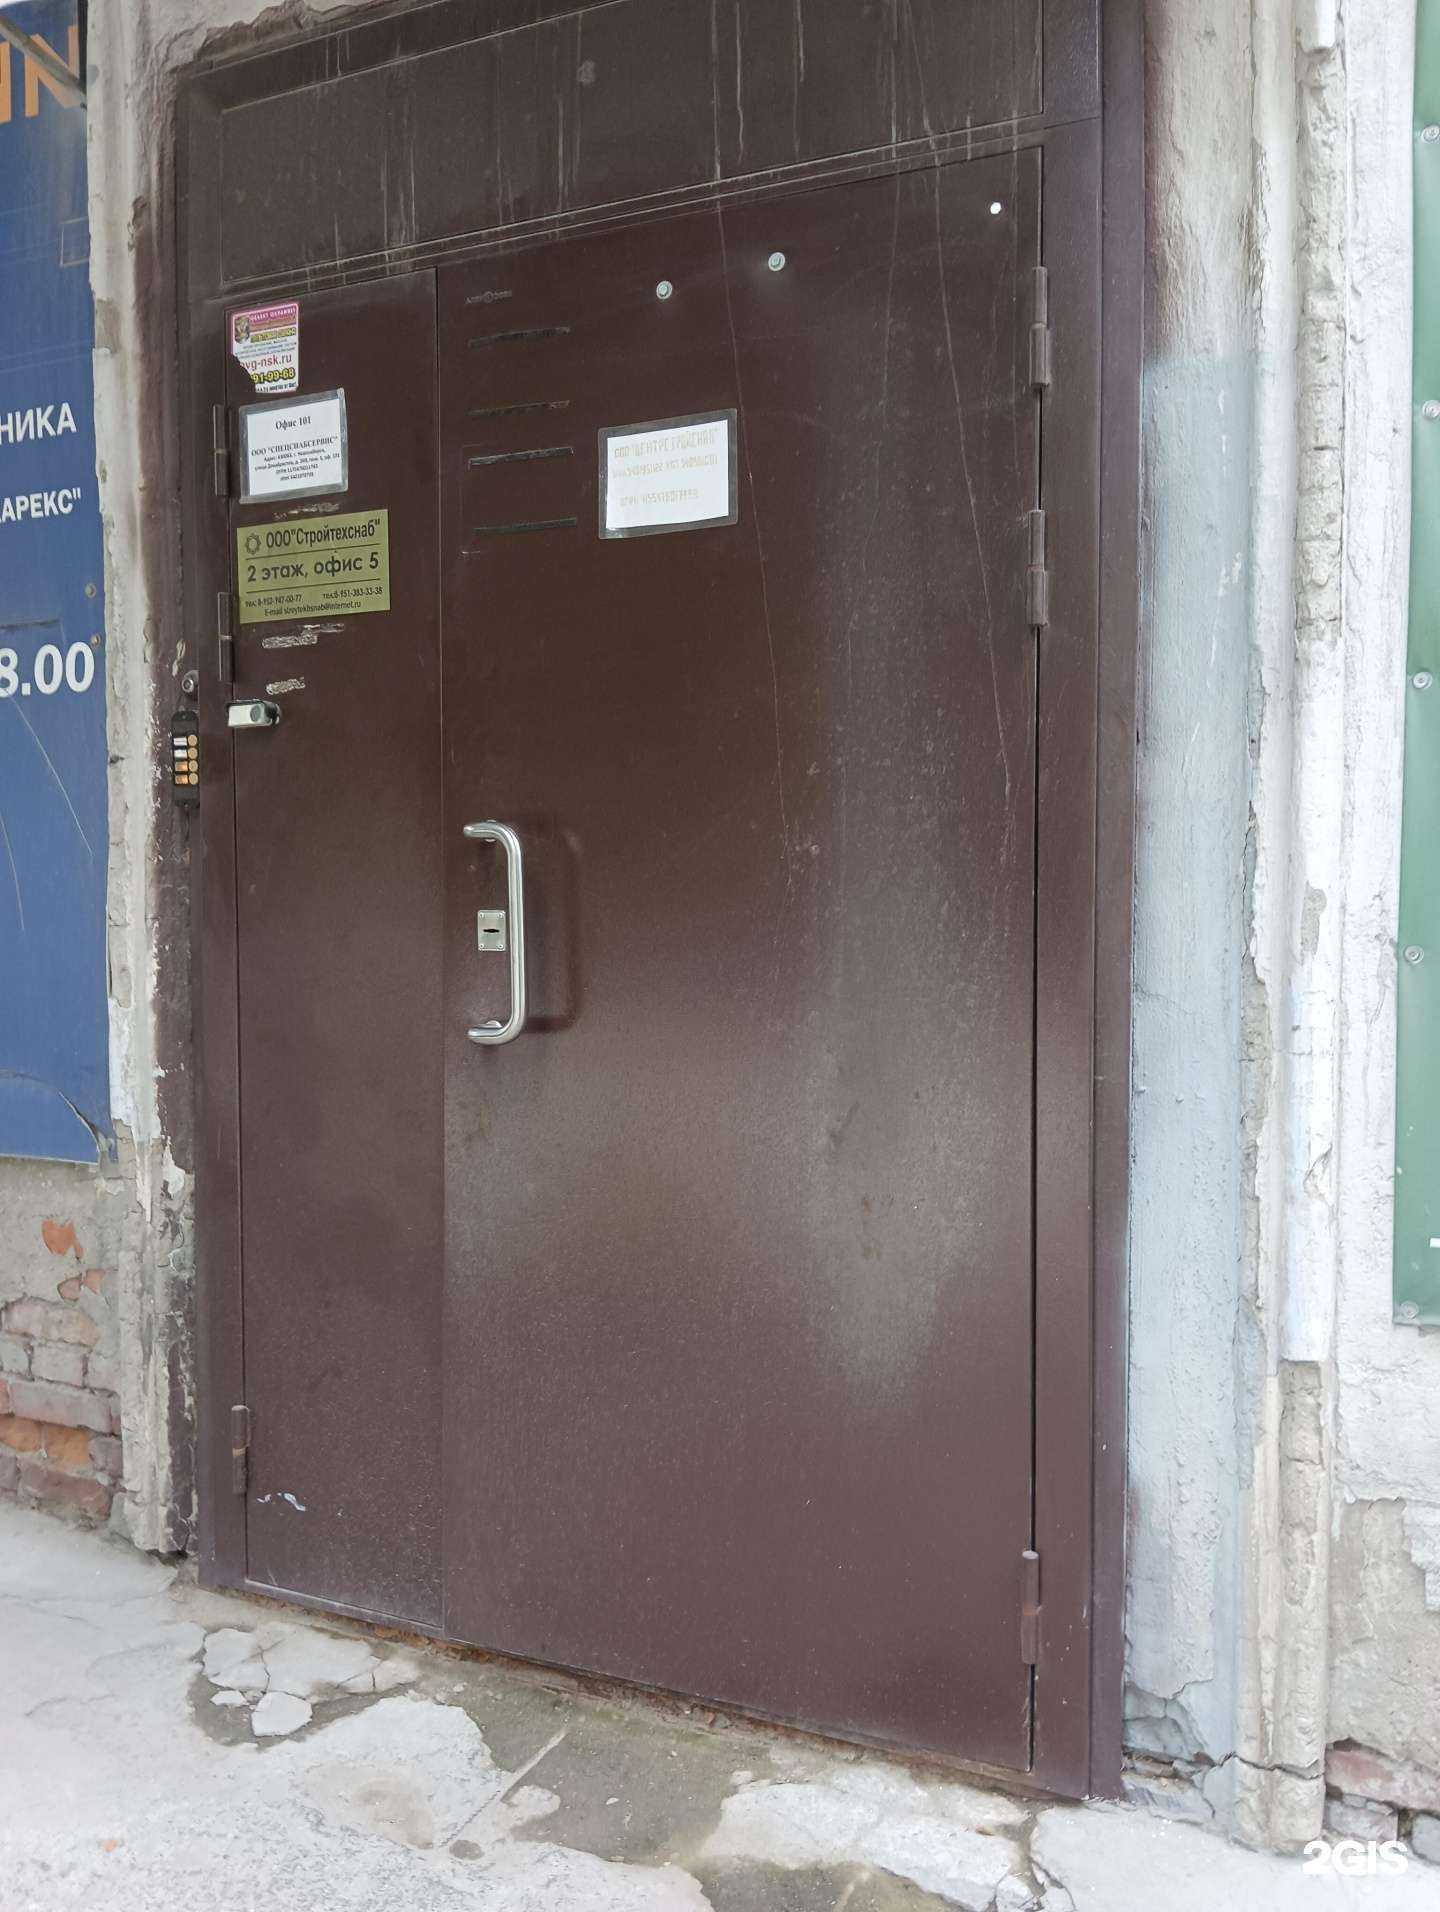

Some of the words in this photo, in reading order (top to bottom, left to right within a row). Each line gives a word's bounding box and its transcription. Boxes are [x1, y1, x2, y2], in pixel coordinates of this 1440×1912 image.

[250, 367, 296, 383] 91-99-68
[0, 402, 77, 446] НИКА
[275, 419, 297, 430] Офис
[299, 415, 311, 426] 101
[251, 447, 267, 457] ООО
[0, 481, 82, 523] АРЕКС"
[266, 517, 381, 549] ООО"Стройтехснаб"
[247, 565, 257, 582] 2
[262, 561, 309, 581] этаж,
[314, 555, 363, 577] офис
[369, 552, 379, 570] 5
[0, 641, 94, 698] 8.00
